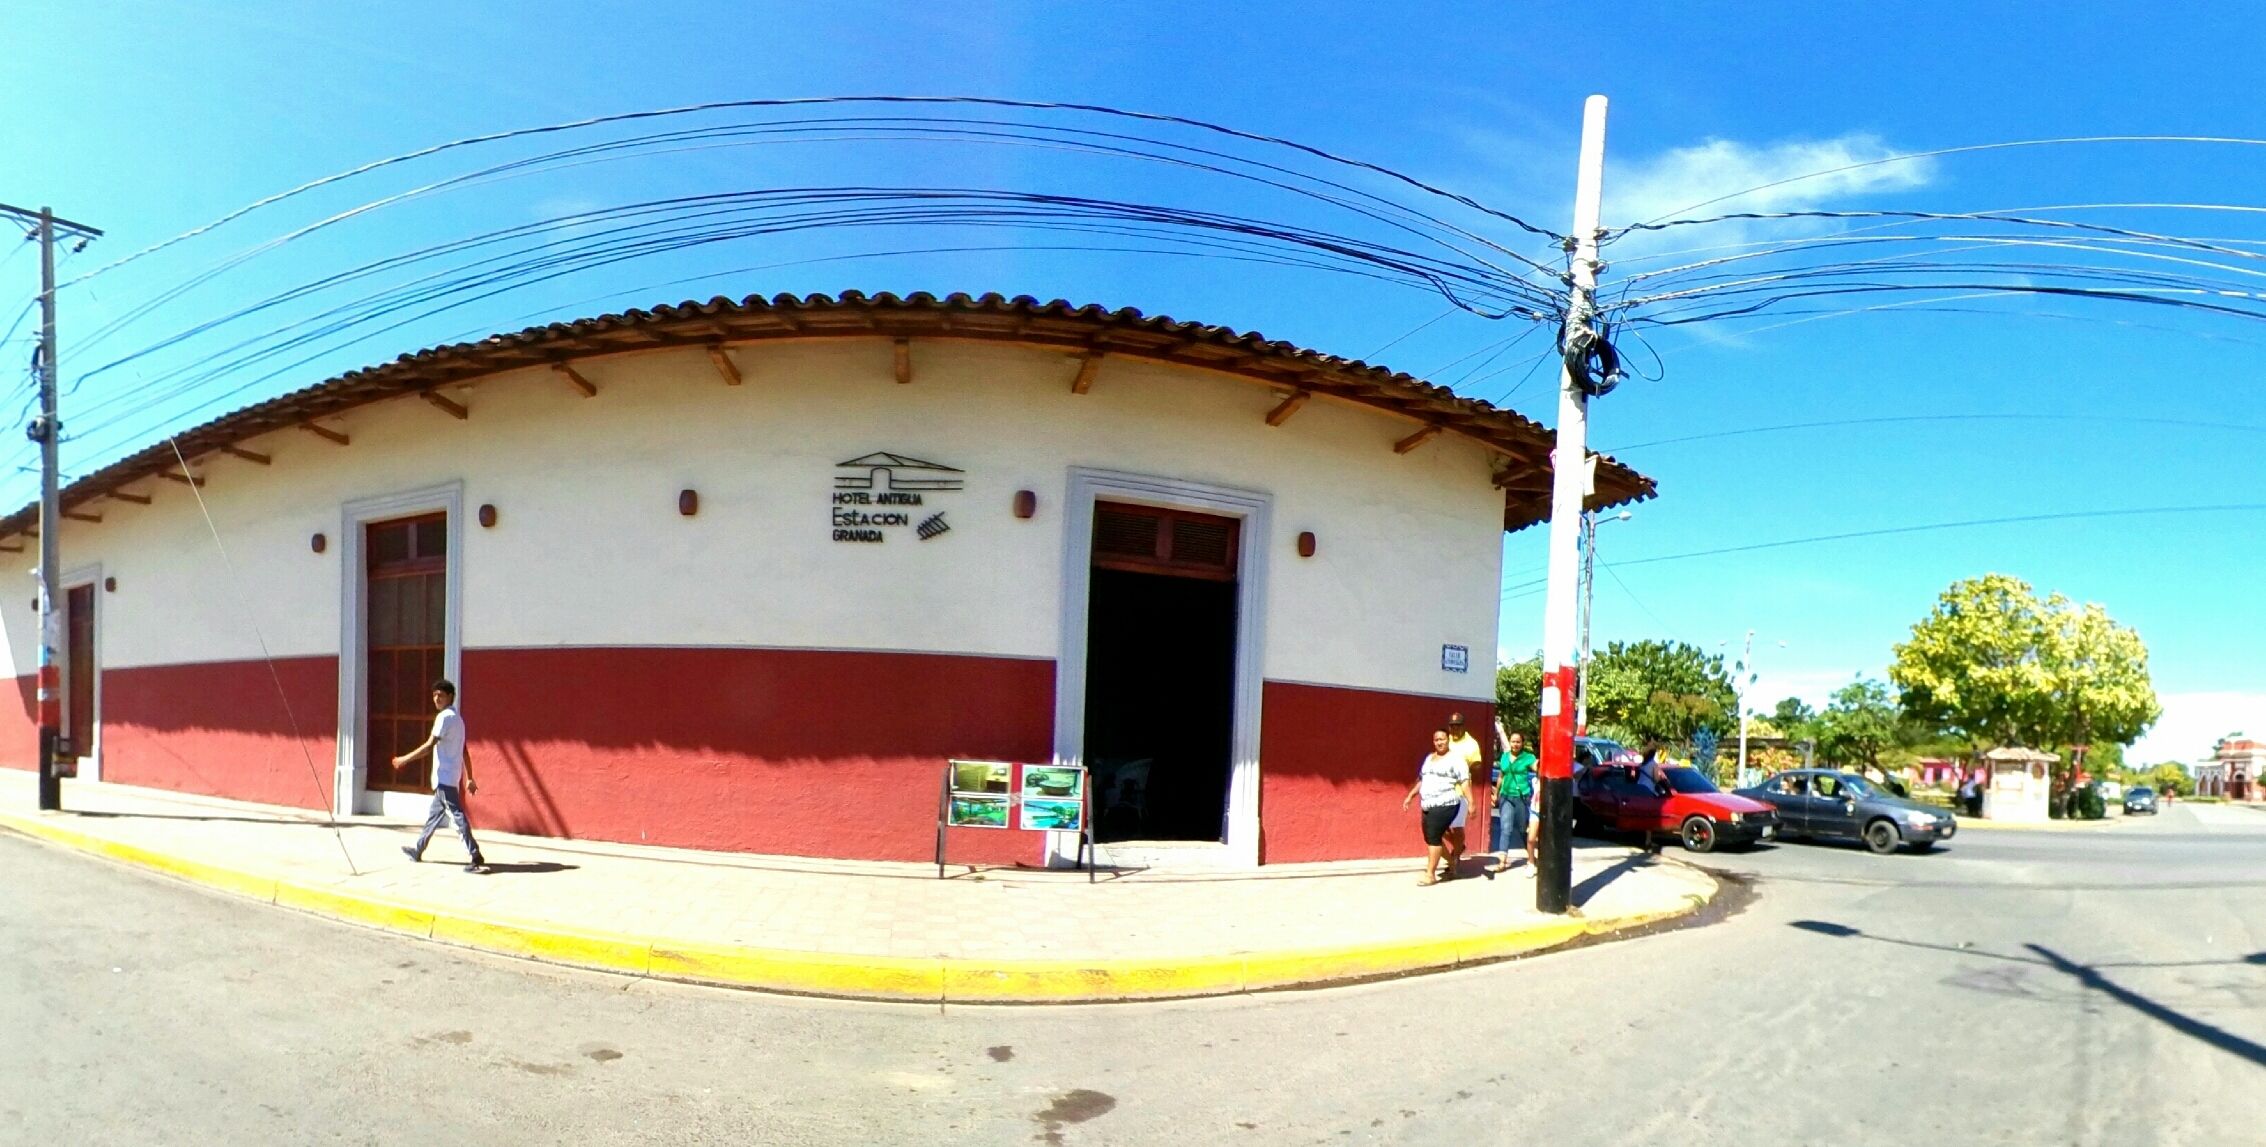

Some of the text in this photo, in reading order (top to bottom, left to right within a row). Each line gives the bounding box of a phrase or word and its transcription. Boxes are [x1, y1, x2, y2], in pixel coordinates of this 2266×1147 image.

[832, 492, 922, 505] HOTEL ANTIGUA
[832, 530, 883, 543] GRANADA
